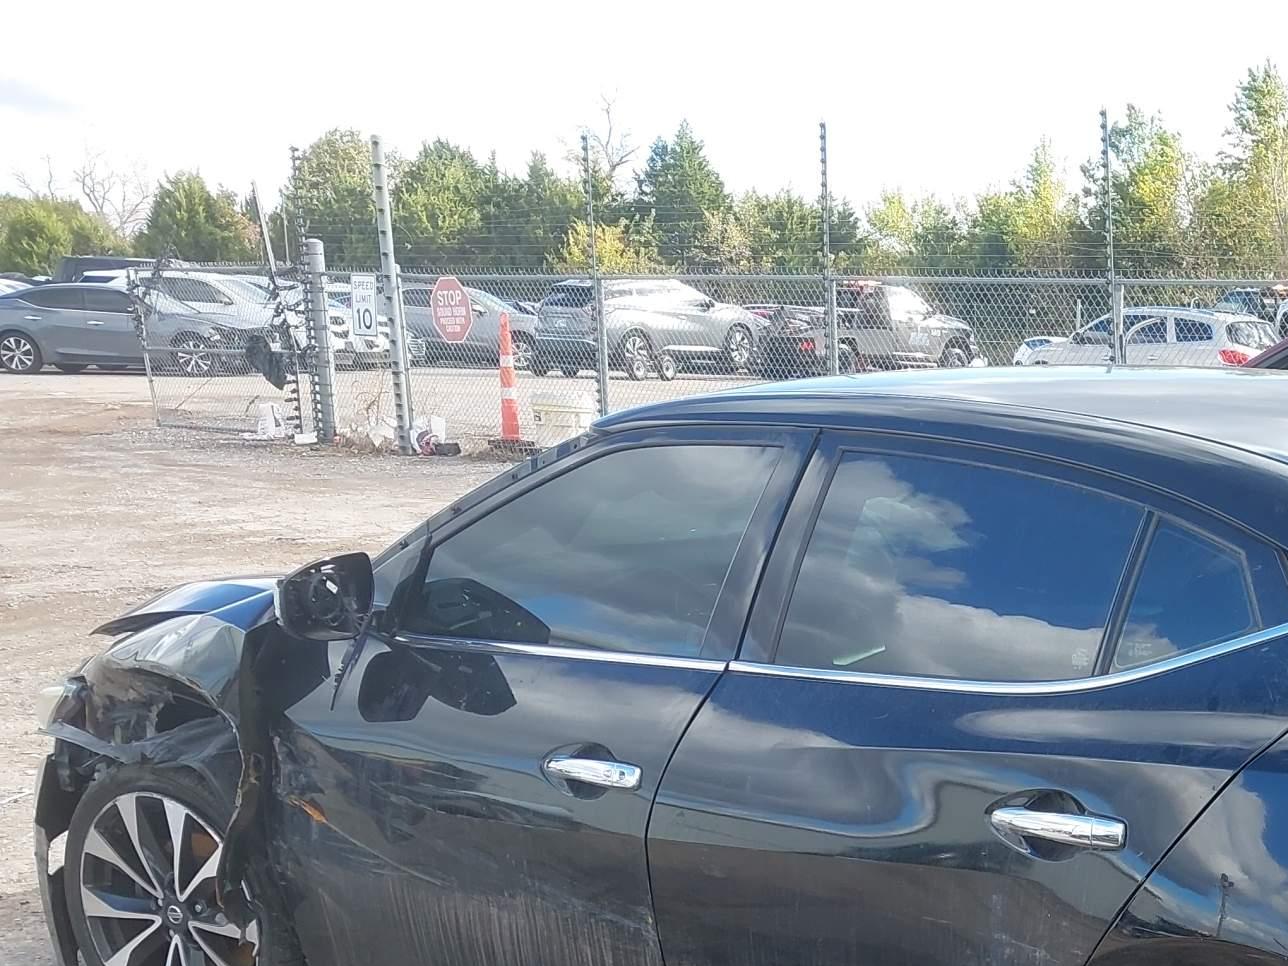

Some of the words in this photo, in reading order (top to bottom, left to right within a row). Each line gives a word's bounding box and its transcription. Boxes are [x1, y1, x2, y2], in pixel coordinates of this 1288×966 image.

[353, 280, 374, 290] SPEED
[355, 294, 372, 304] LIMIT
[437, 290, 462, 306] STOP
[356, 308, 373, 330] 10
